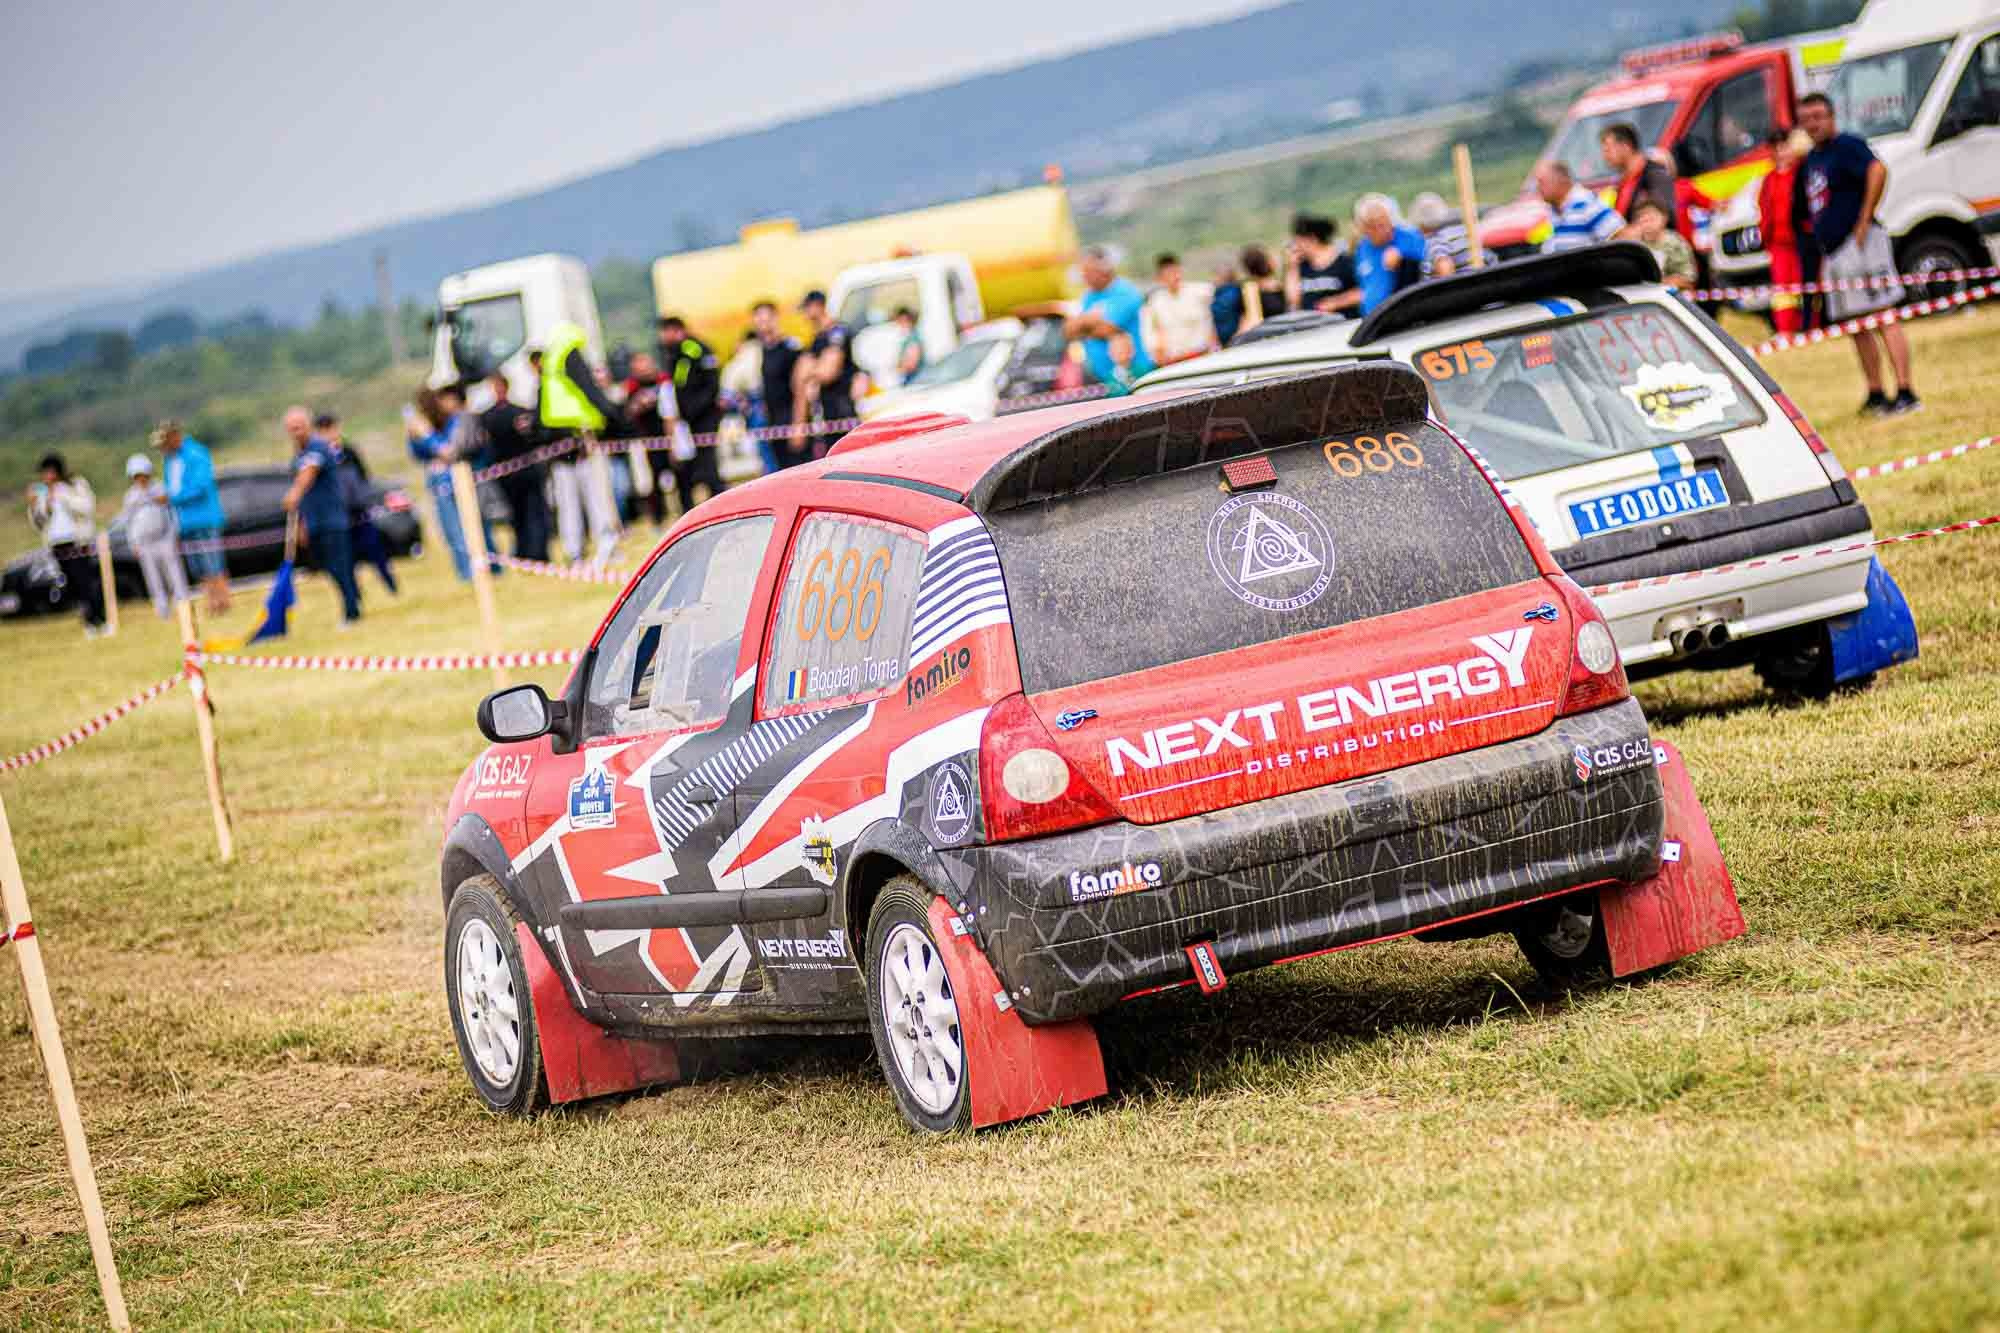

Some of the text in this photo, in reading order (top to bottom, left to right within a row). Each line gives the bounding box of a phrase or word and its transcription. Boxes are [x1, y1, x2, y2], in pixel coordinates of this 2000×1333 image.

[1421, 341, 1496, 380] 675
[1324, 432, 1424, 478] 686
[1257, 494, 1304, 514] ENERGY
[1580, 477, 1715, 530] TEODORA
[795, 548, 892, 641] 686
[1243, 574, 1330, 609] DISTRIBUTION
[809, 656, 898, 696] Bogdan Toma
[906, 648, 971, 705] famiro
[1107, 626, 1534, 777] NEXT ENERGY
[1247, 718, 1446, 774] DISTRIBUTION
[1594, 746, 1622, 767] CIS
[1623, 738, 1652, 760] GAZ
[501, 753, 532, 785] GAZ
[1070, 862, 1161, 895] famiro
[758, 928, 847, 957] NEXT ENERGY
